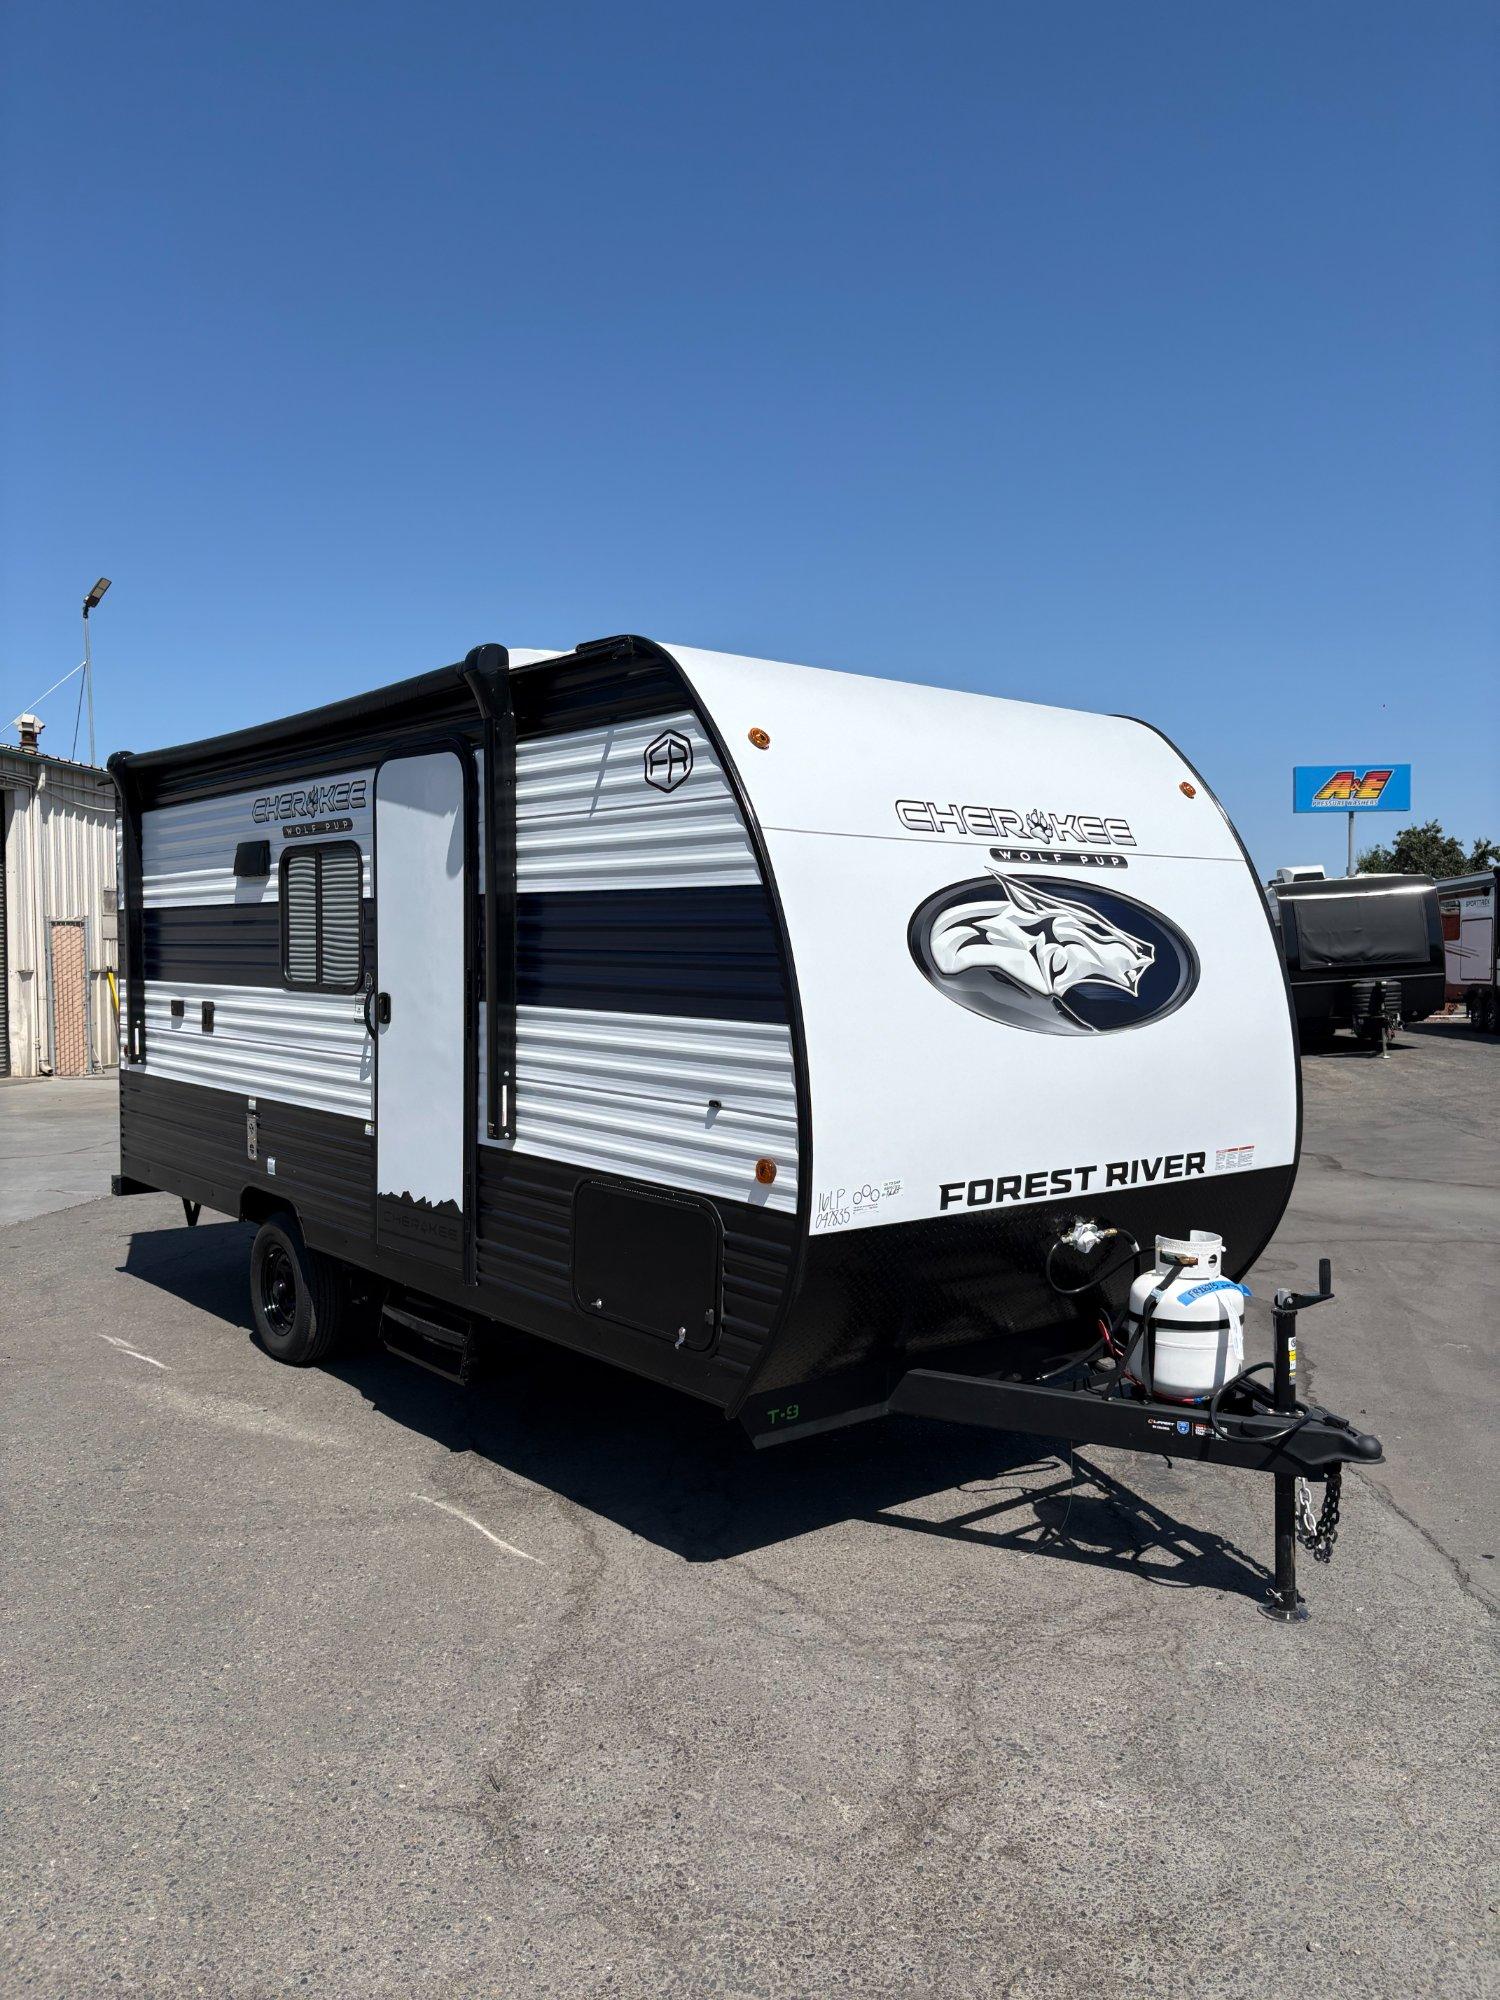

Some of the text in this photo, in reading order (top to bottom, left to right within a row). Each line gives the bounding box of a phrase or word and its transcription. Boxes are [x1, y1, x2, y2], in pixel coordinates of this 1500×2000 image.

[1312, 769, 1394, 801] A&E
[286, 820, 349, 836] WOLF PUP
[998, 850, 1120, 867] WOLF PUP
[939, 1165, 1098, 1211] FOREST
[1105, 1151, 1206, 1188] RIVER
